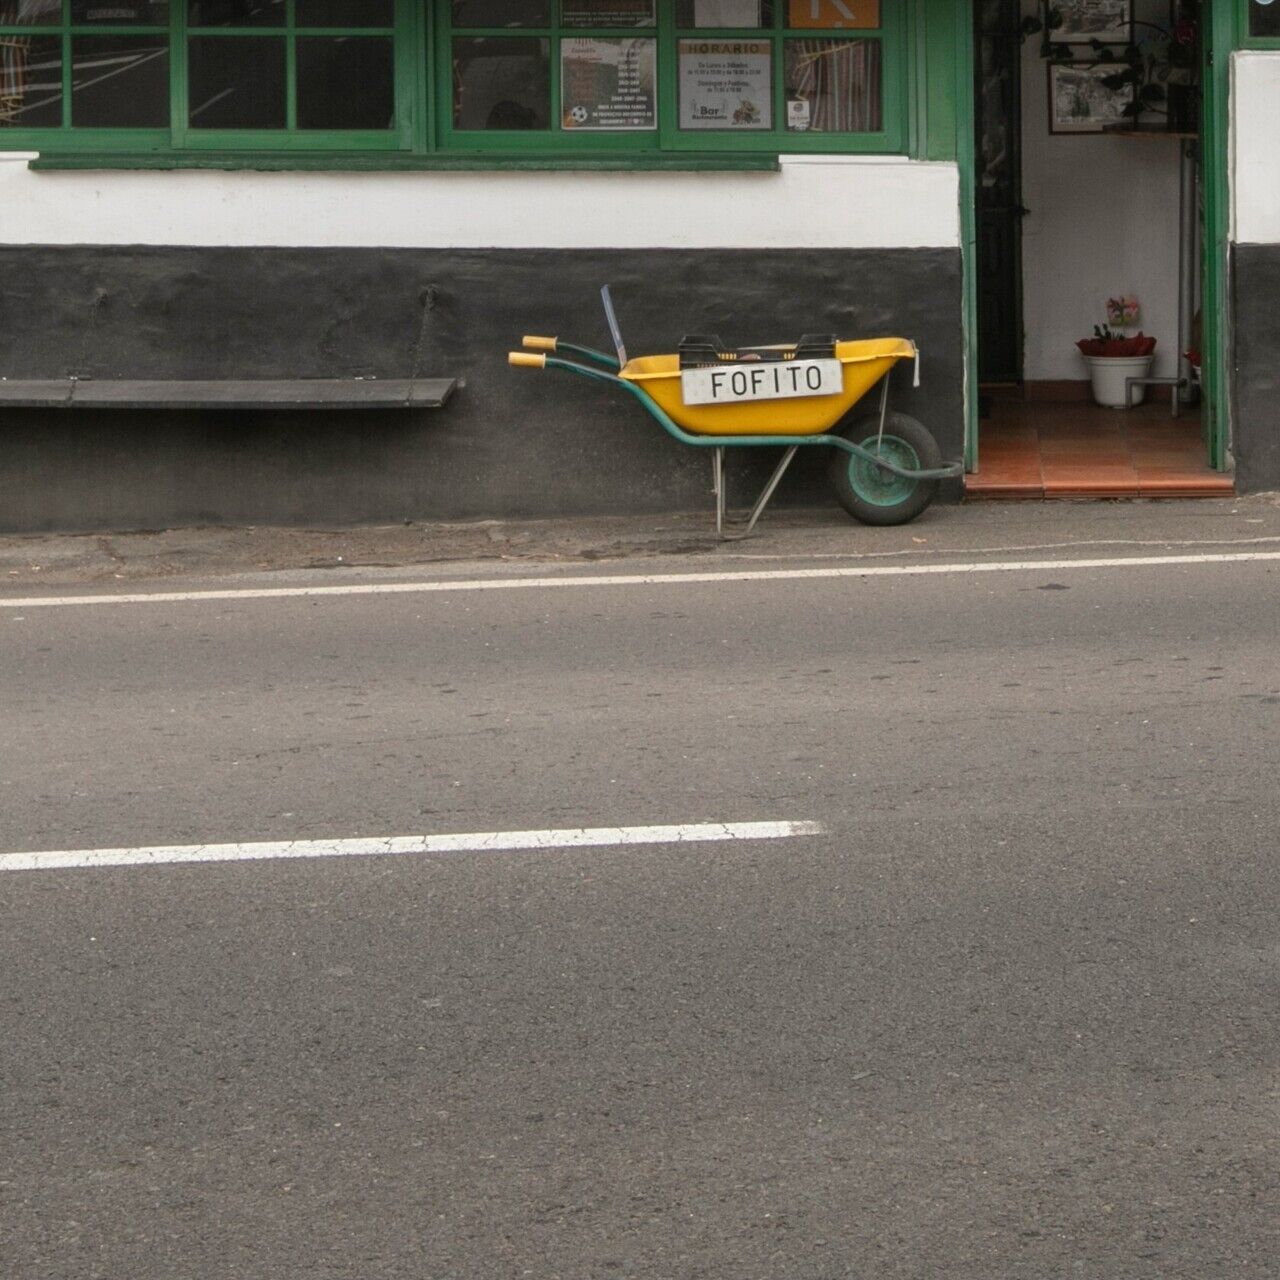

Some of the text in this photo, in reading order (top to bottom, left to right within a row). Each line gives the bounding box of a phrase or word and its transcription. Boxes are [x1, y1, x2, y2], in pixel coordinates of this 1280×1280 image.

[688, 43, 759, 54] HORARIO
[700, 106, 719, 115] Bar
[711, 365, 822, 398] FOFITO
